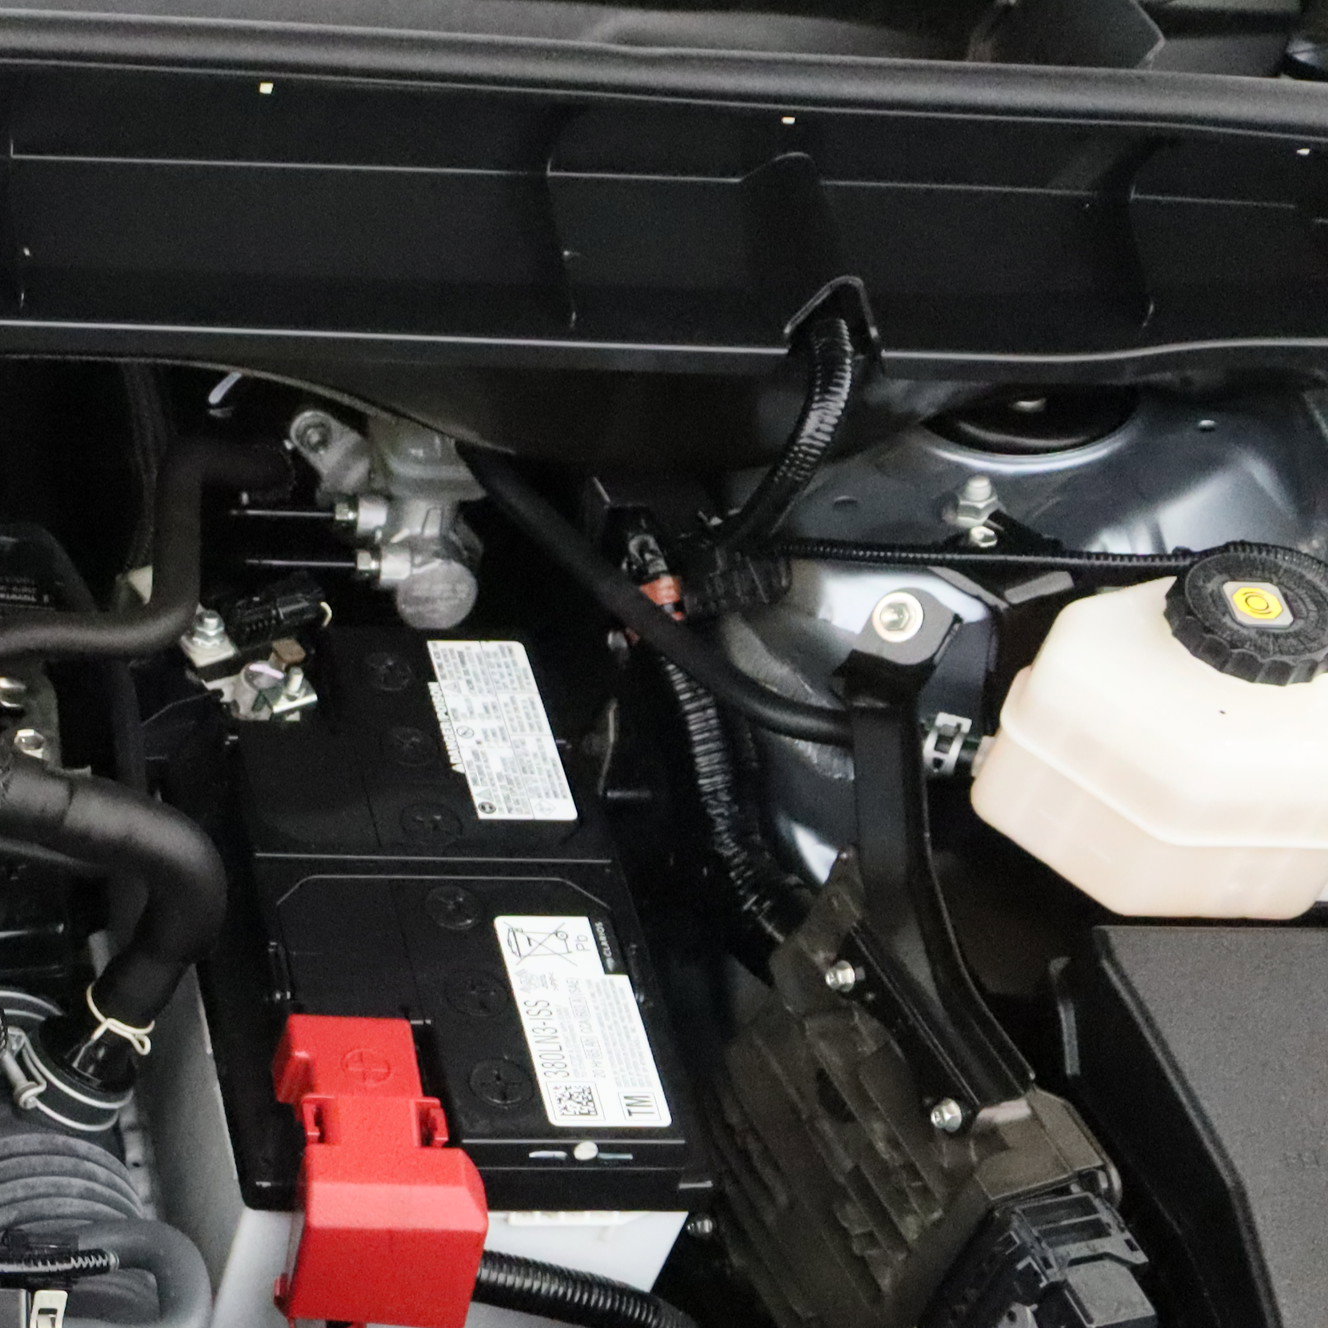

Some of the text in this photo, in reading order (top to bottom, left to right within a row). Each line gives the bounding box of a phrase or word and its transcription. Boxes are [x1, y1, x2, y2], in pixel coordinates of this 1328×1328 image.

[575, 934, 591, 952] Pb
[594, 921, 613, 959] CLARIOS
[523, 999, 570, 1078] 380LN3-ISS
[623, 1095, 655, 1117] TM
